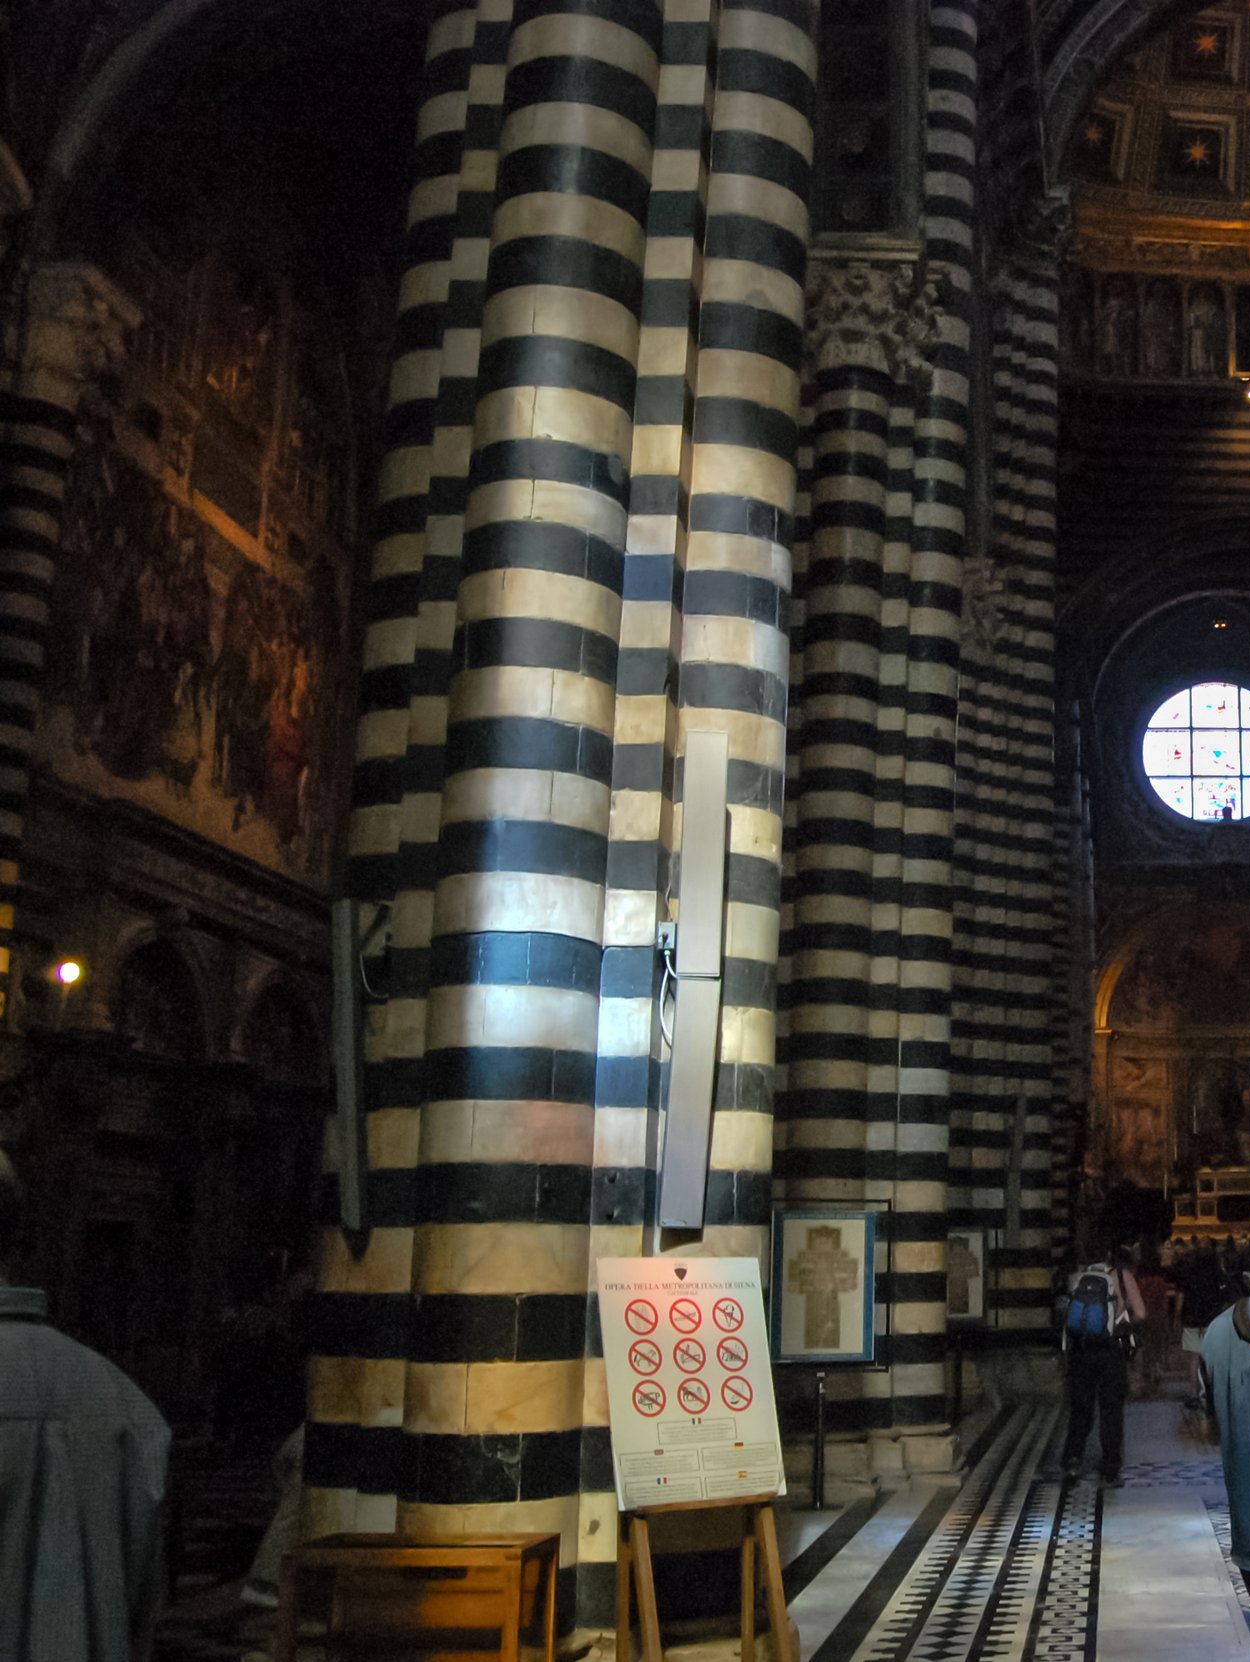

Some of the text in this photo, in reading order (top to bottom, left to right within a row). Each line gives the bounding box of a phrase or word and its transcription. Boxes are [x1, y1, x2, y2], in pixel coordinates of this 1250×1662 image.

[604, 1282, 631, 1291] OPERA
[633, 1282, 660, 1290] DELLA
[662, 1281, 723, 1290] METROPOLITANA
